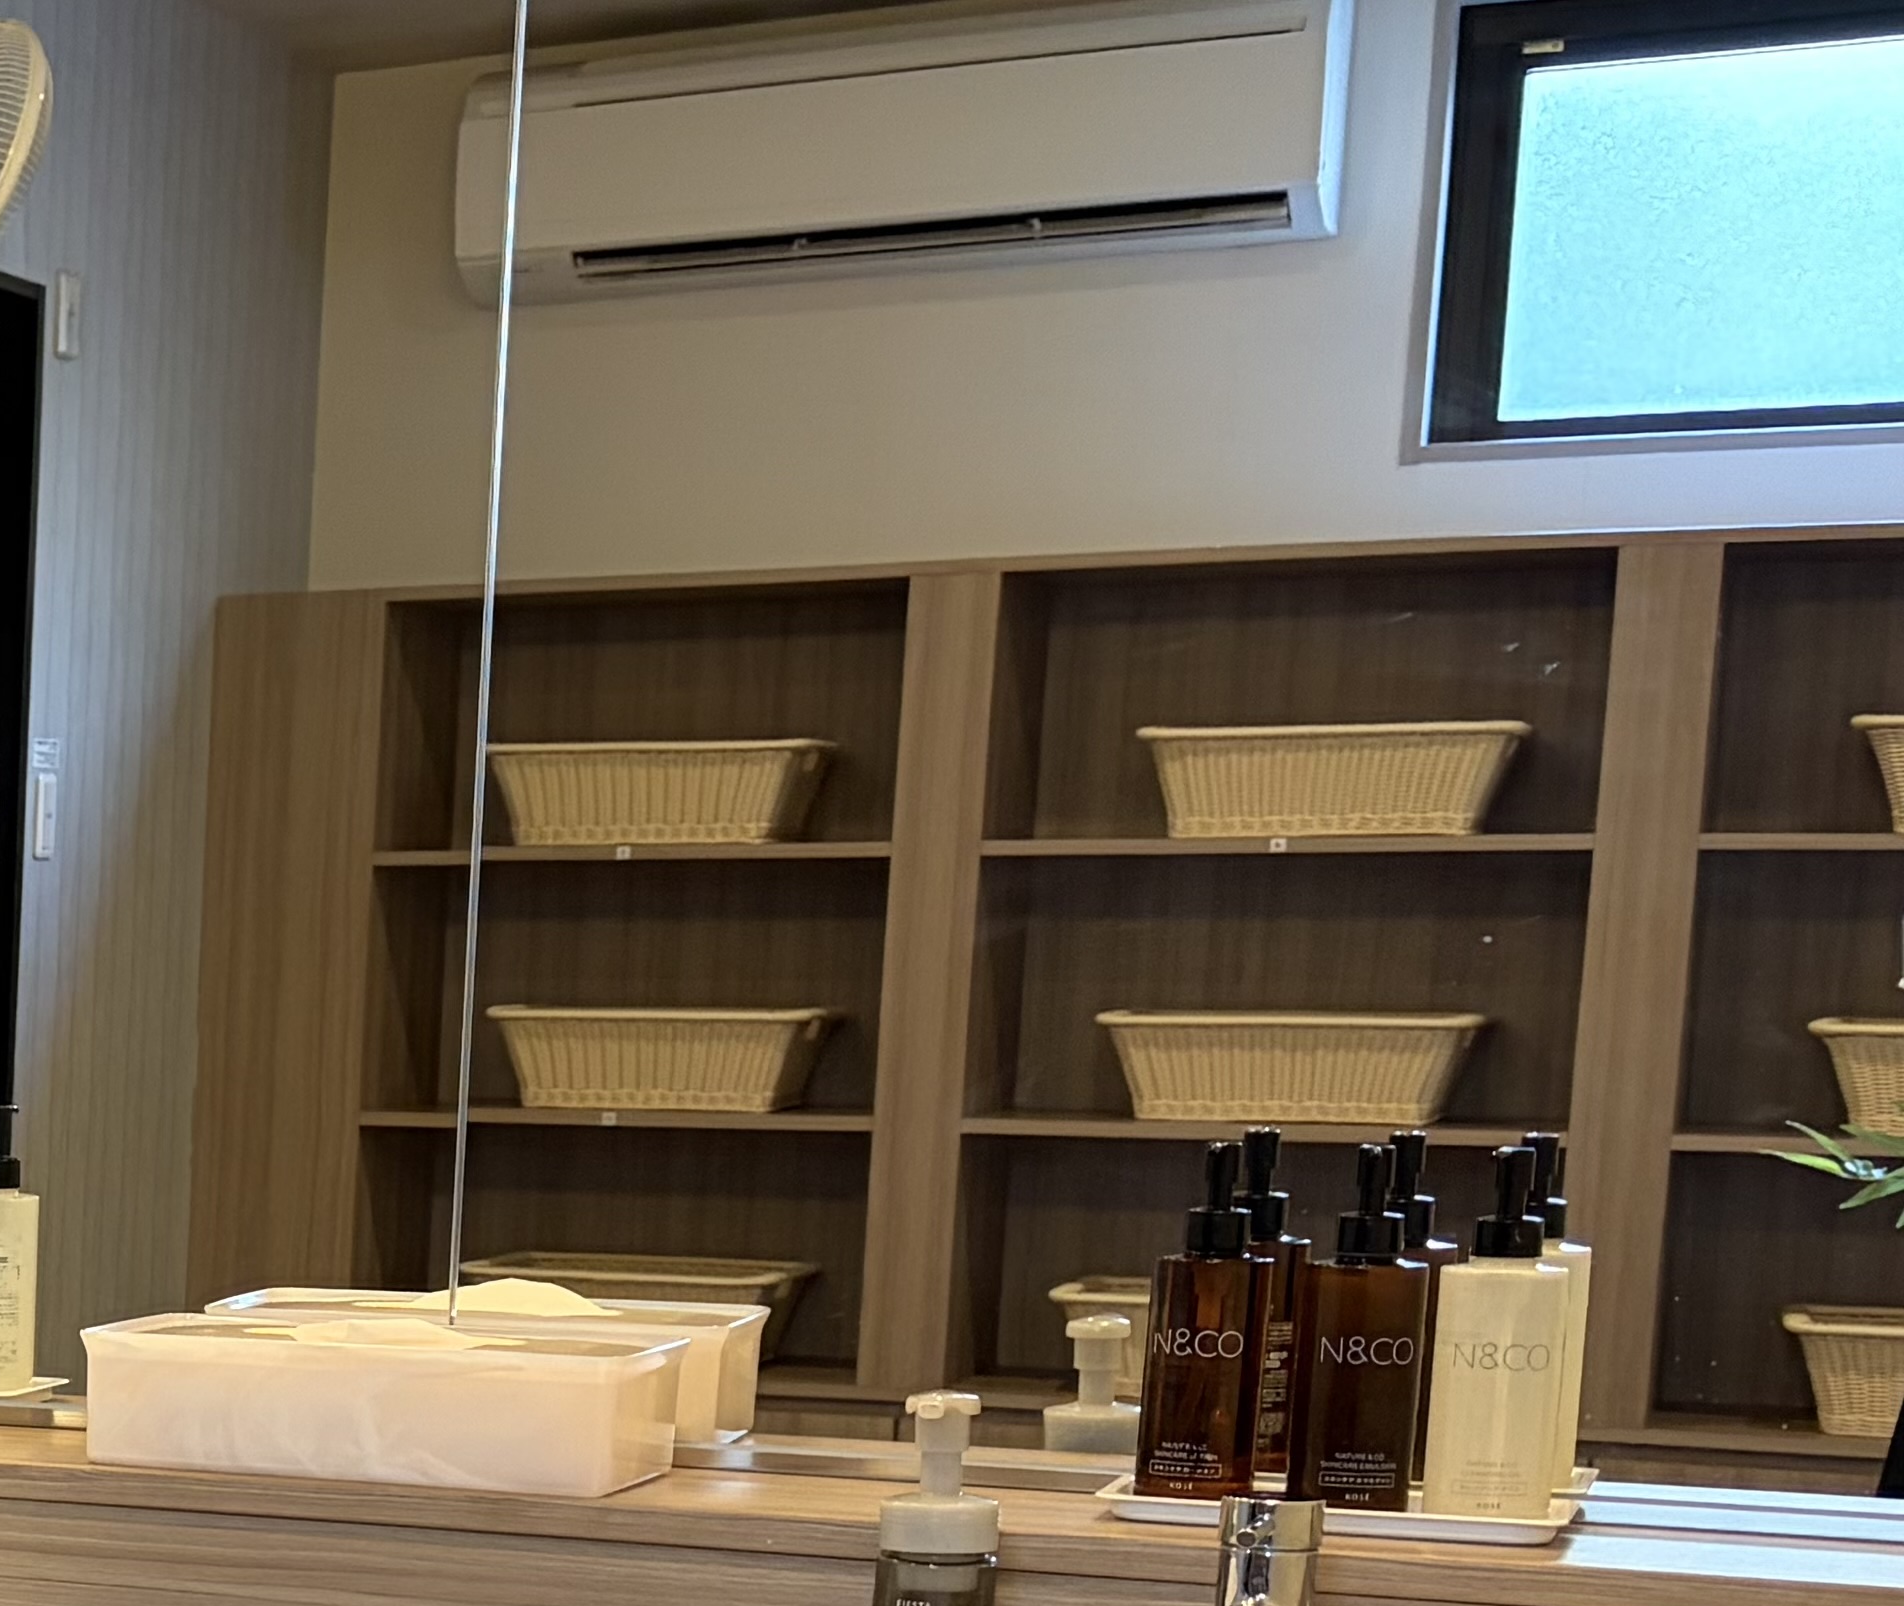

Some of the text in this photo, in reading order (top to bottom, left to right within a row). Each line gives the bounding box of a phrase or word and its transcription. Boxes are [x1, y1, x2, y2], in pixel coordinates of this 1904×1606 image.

[1154, 1328, 1244, 1358] N&CO
[1320, 1336, 1414, 1365] N&CO
[1453, 1342, 1551, 1372] N&CO
